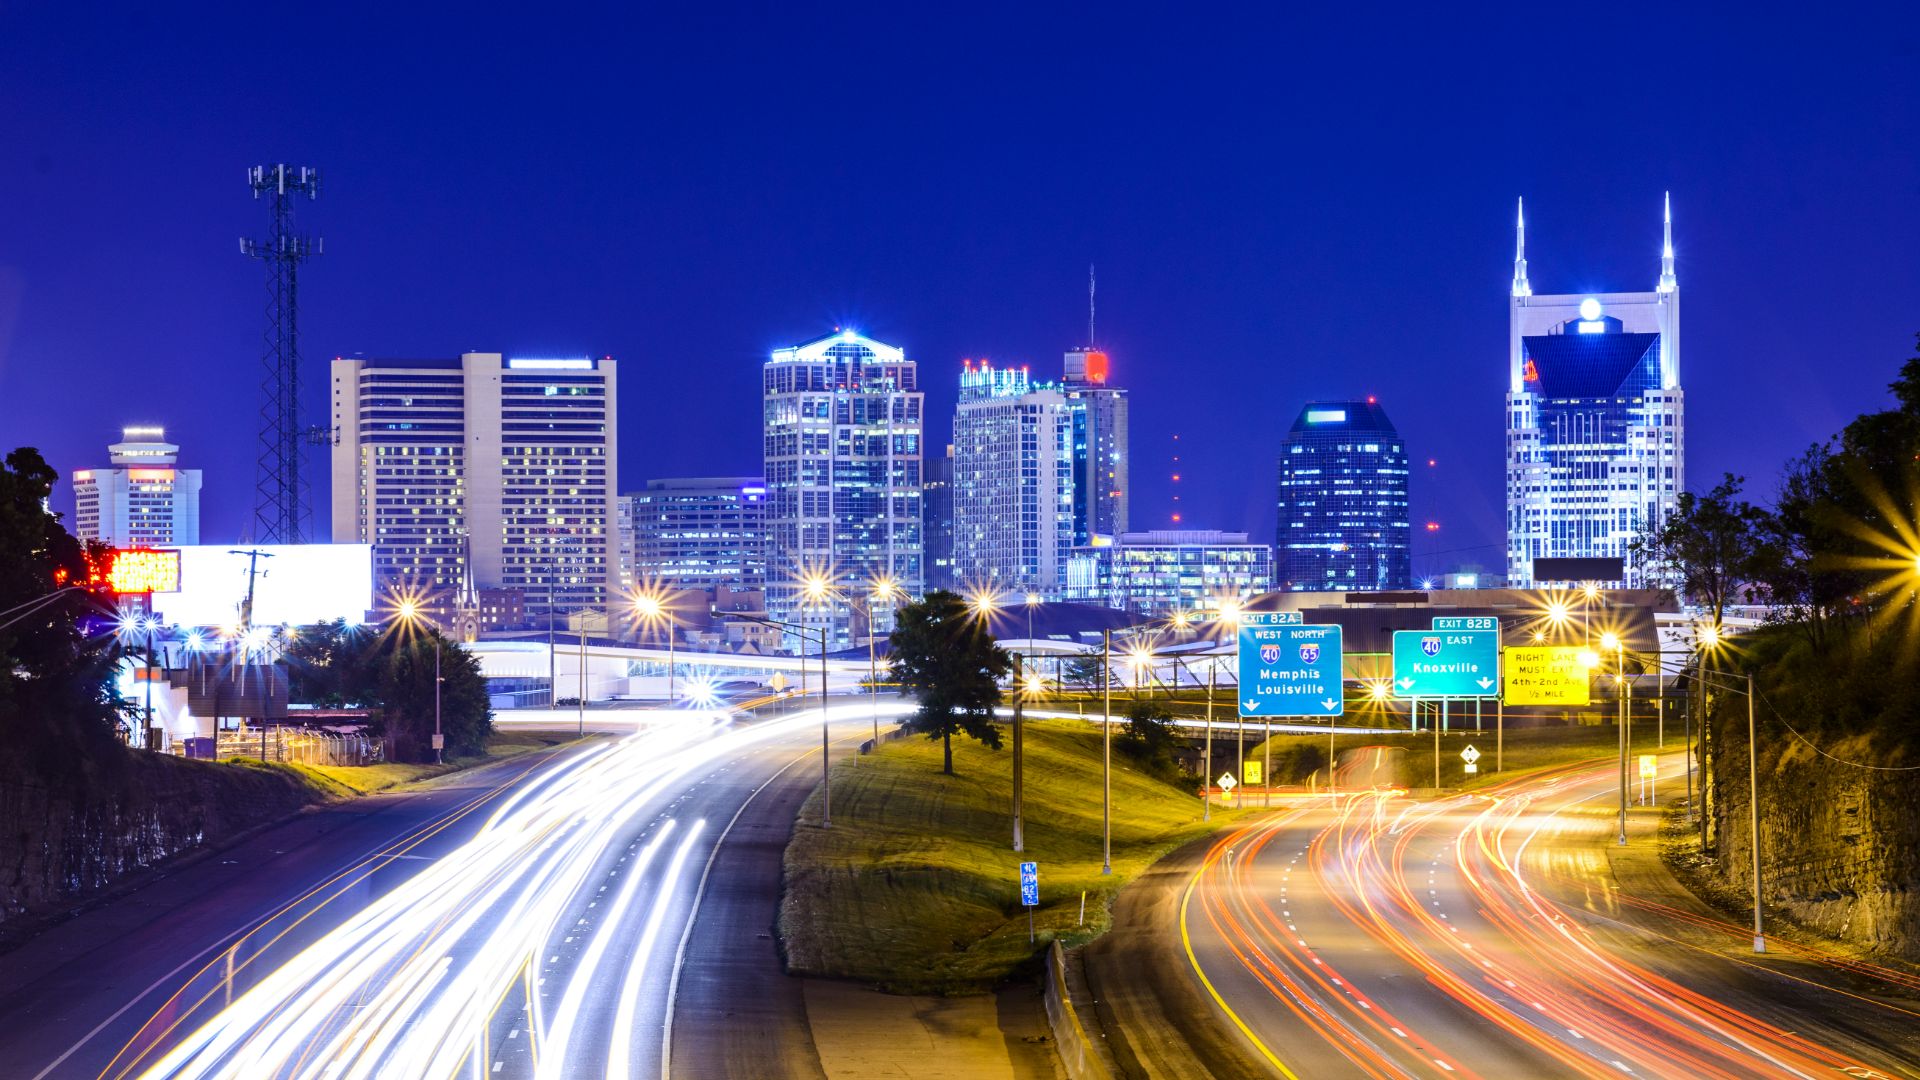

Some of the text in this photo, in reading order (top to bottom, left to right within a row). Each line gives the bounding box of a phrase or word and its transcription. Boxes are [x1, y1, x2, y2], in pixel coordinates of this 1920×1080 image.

[1243, 614, 1296, 623] EXIT 82A
[1439, 619, 1492, 629] EXIT 82B
[1255, 630, 1325, 639] WEST NORTH
[1446, 636, 1474, 644] EAST
[1424, 642, 1439, 653] 40
[1263, 649, 1317, 660] 40 65
[1515, 654, 1577, 662] RIGHT LANE
[1413, 663, 1478, 673] Knoxville
[1519, 666, 1573, 674] MUST EXIT
[1260, 669, 1320, 680] Memphis
[1257, 685, 1324, 694] Louisville
